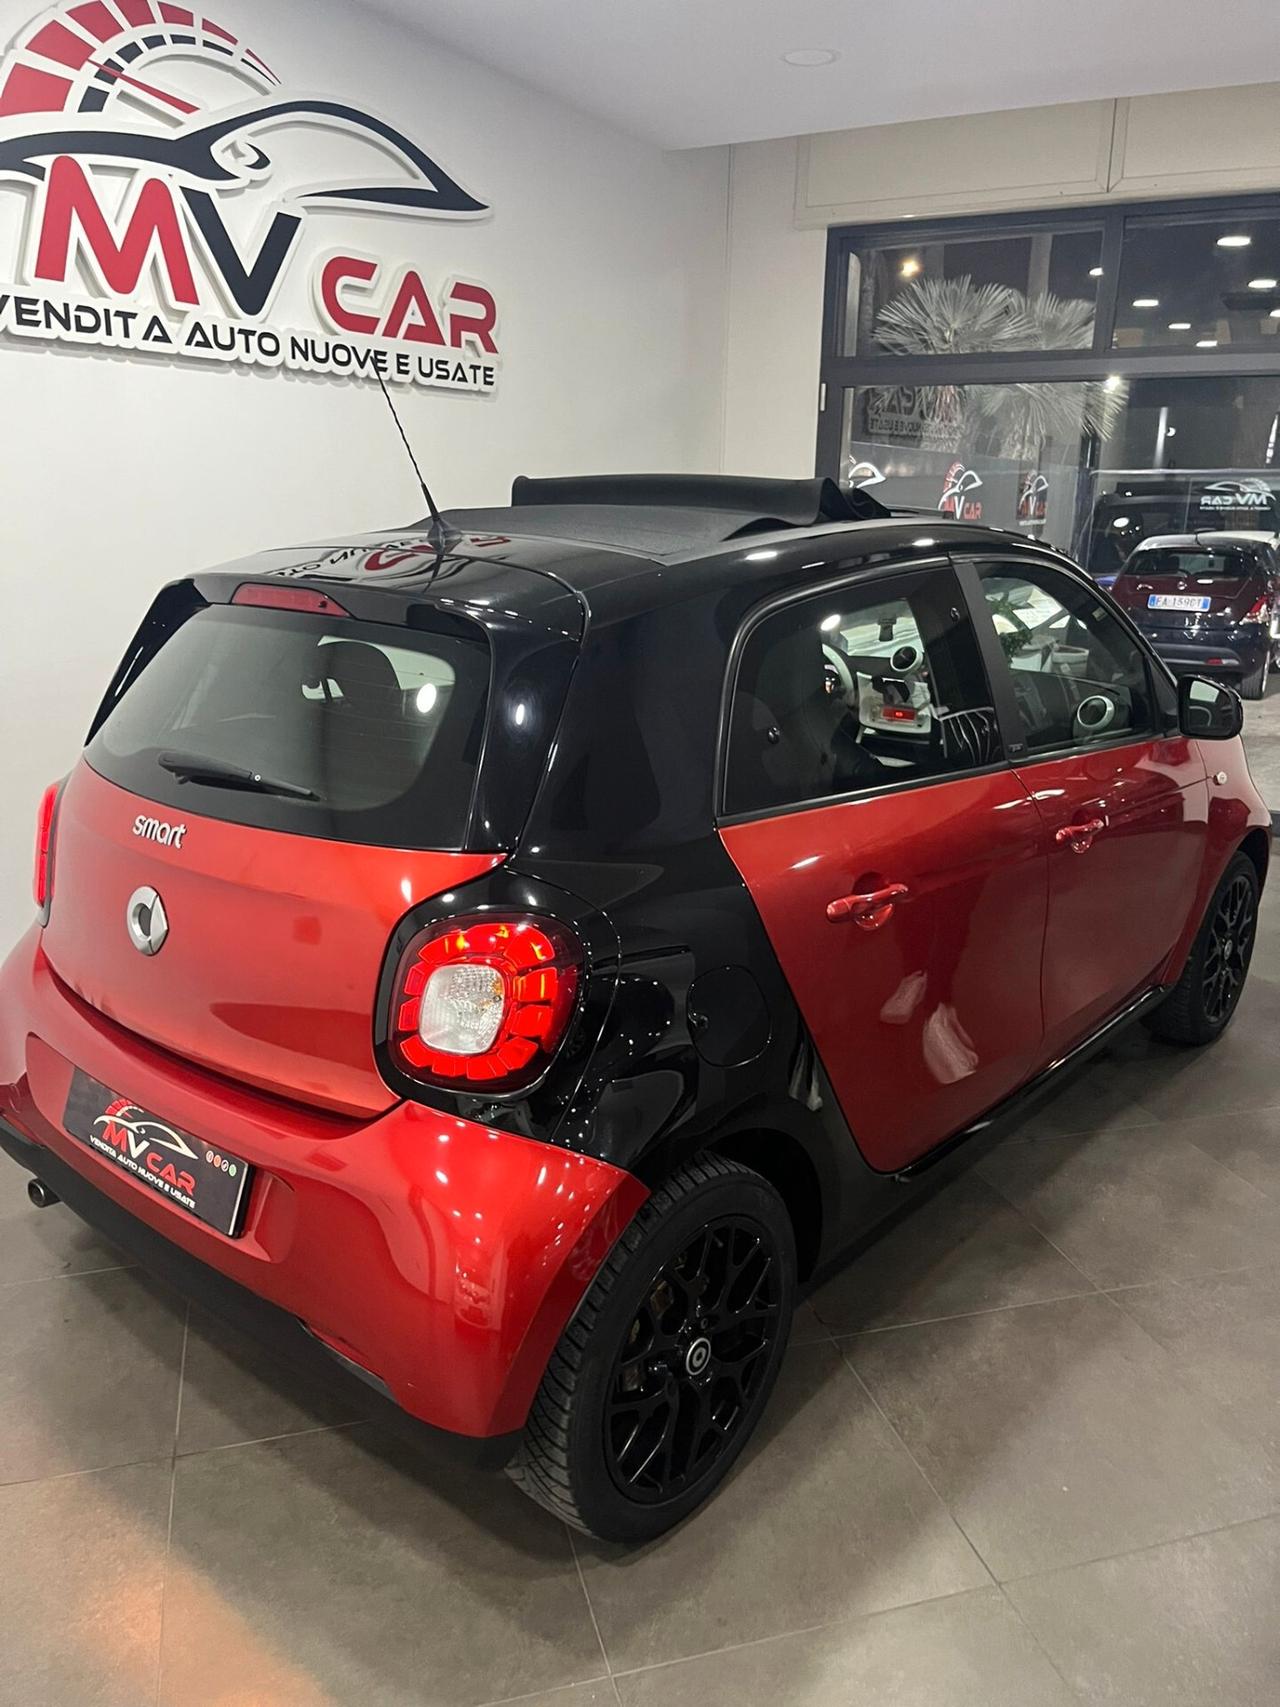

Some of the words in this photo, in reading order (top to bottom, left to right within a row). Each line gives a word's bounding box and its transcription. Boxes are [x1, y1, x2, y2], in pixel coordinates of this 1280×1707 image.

[34, 155, 302, 316] MV
[321, 255, 499, 354] CAR
[184, 321, 281, 357] AUTO
[290, 336, 388, 373] NUOVE
[396, 353, 411, 375] E
[418, 357, 495, 386] USATE
[132, 814, 187, 849] smart
[102, 1120, 151, 1159] MV
[146, 1152, 196, 1196] CAR
[117, 1154, 138, 1170] AUTO
